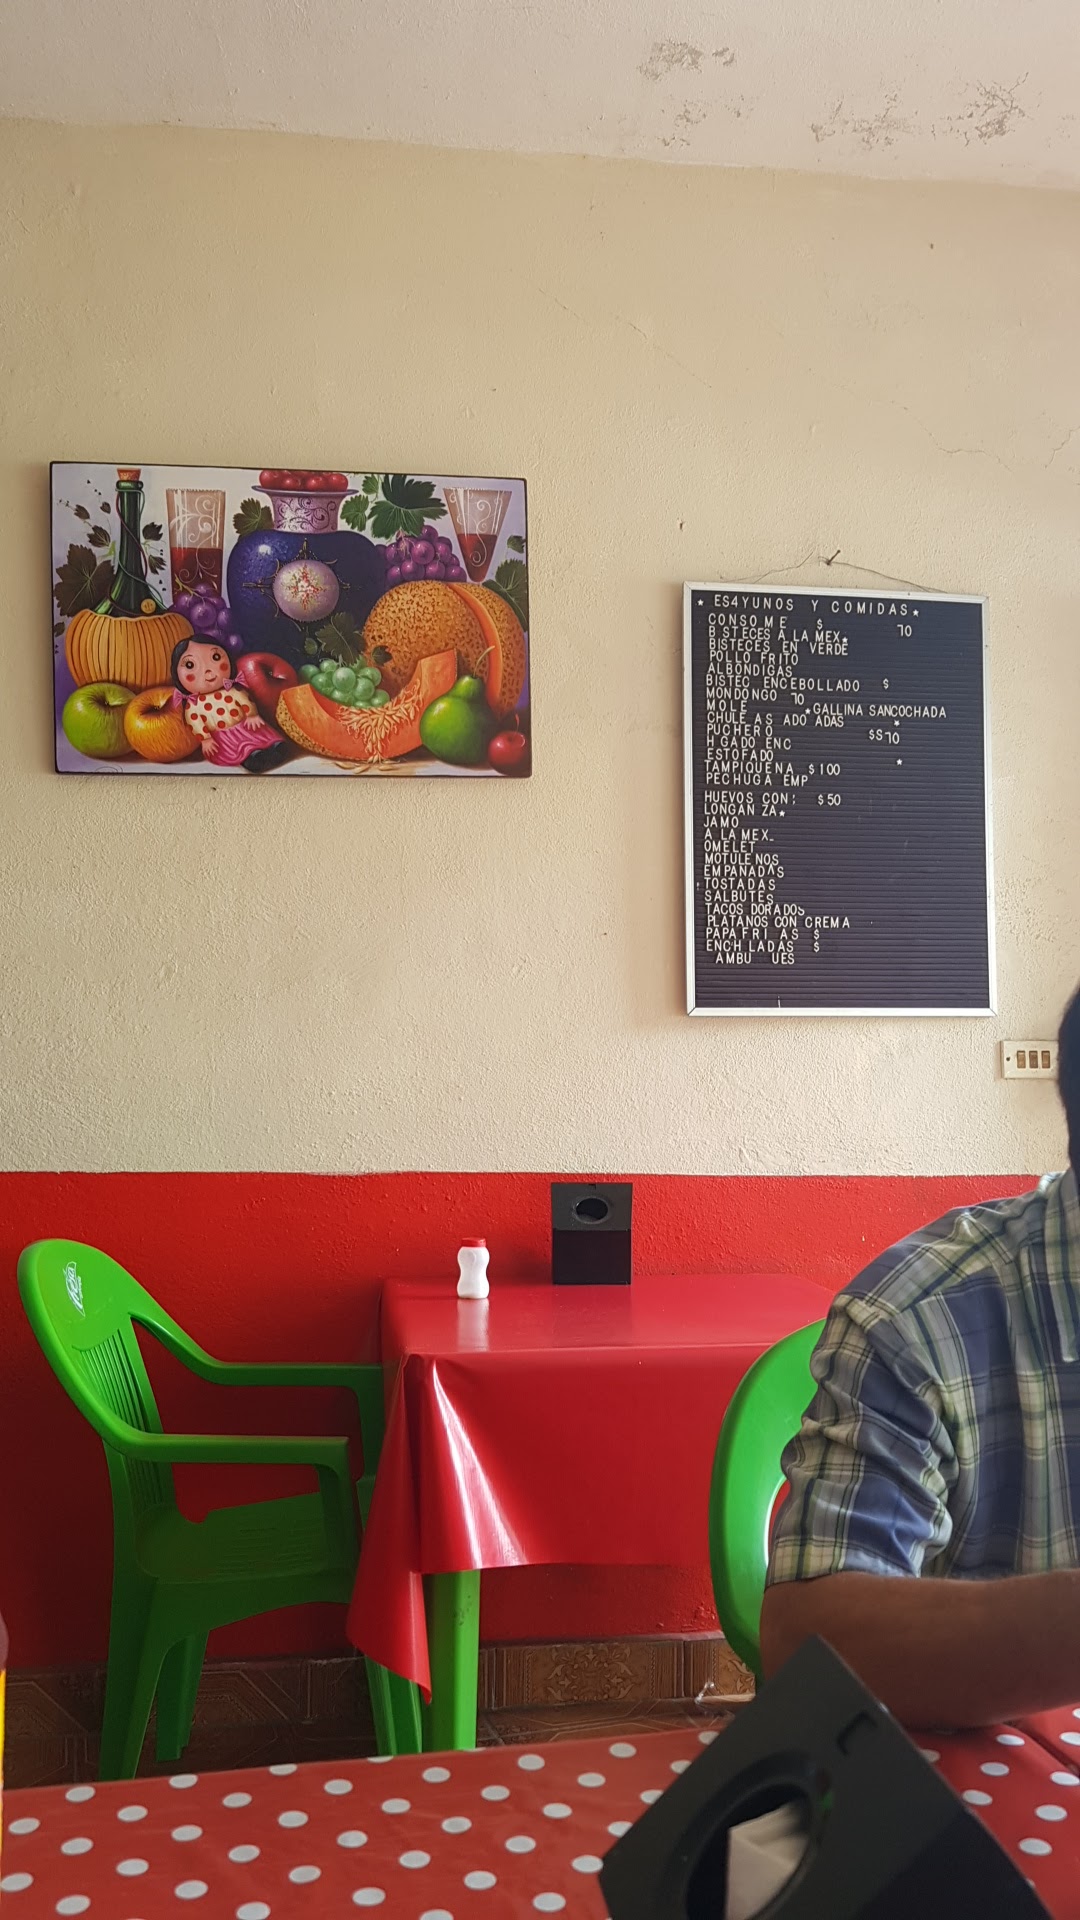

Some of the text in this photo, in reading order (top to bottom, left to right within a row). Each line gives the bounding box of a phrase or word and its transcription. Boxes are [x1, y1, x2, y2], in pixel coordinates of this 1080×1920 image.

[811, 599, 819, 612] Y
[831, 600, 908, 616] COMIDAS
[816, 618, 823, 631] $
[777, 628, 786, 641] A
[793, 629, 809, 642] LA
[709, 637, 849, 656] BISTECES EN VERDE
[709, 650, 799, 666] POLLO FRITO
[707, 661, 793, 678] ALBONDIGAS
[706, 673, 889, 692] BISTEC ENCEBOLLADO $
[706, 686, 778, 702] MONDONGO
[706, 698, 748, 713] MOLE
[812, 702, 947, 719] GALLINA SANCOCHADA
[765, 736, 792, 751] ENC
[707, 747, 774, 762] ESTOFADO
[704, 759, 794, 775] TAMPIQUENA
[706, 771, 809, 787] PECHUGA EMP
[704, 790, 754, 805] HUEVOS
[817, 792, 842, 807] $50
[703, 815, 739, 829] JAMO
[703, 827, 713, 840] A
[720, 828, 737, 841] LA
[703, 839, 756, 853] OMELET
[703, 864, 785, 879] EMPANADAS
[703, 876, 776, 892] TOSTADAS
[704, 889, 774, 906] SALBUTES
[704, 902, 806, 918] TACOS DORADOS
[707, 914, 851, 930] PLATANOS CON CREMA
[813, 928, 820, 941] $
[813, 940, 820, 953] $
